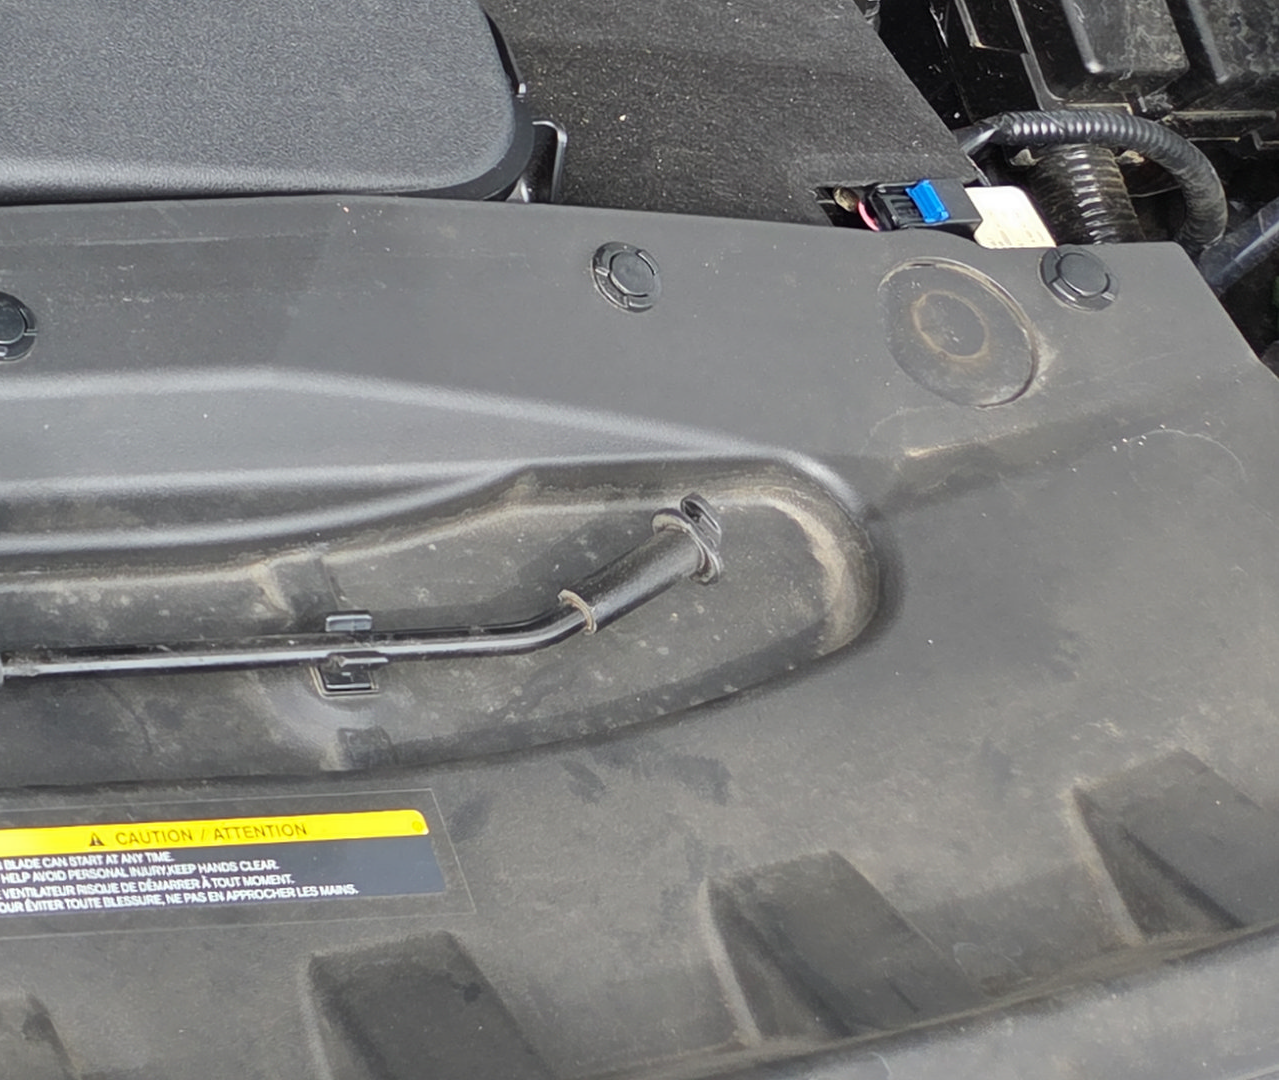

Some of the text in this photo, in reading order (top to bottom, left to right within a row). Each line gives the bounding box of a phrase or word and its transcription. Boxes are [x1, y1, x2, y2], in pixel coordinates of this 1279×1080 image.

[114, 828, 193, 845] CAUTION
[211, 822, 308, 840] ATTENTION
[0, 871, 32, 883] HELP
[30, 869, 68, 882] AVOID
[67, 866, 129, 880] PERSONAL
[196, 861, 239, 874] HANDS
[2, 857, 42, 870] BLADE
[40, 856, 68, 868] CAN
[68, 854, 104, 866] START
[104, 853, 120, 865] AT
[119, 852, 144, 864] ANY
[144, 851, 175, 863] TIME.
[1, 885, 76, 899] VENTILATEUR
[75, 882, 121, 895] RISQUE
[119, 881, 137, 892] DE
[136, 876, 201, 891] DÉMARRER
[209, 876, 242, 888] TOUT
[23, 896, 65, 911] ÉVITER
[64, 897, 103, 909] TOUTE
[164, 893, 184, 904] NE
[183, 892, 208, 903] PAS
[207, 891, 225, 902] EN
[223, 887, 297, 901] APPROCHER
[295, 886, 319, 897] LES
